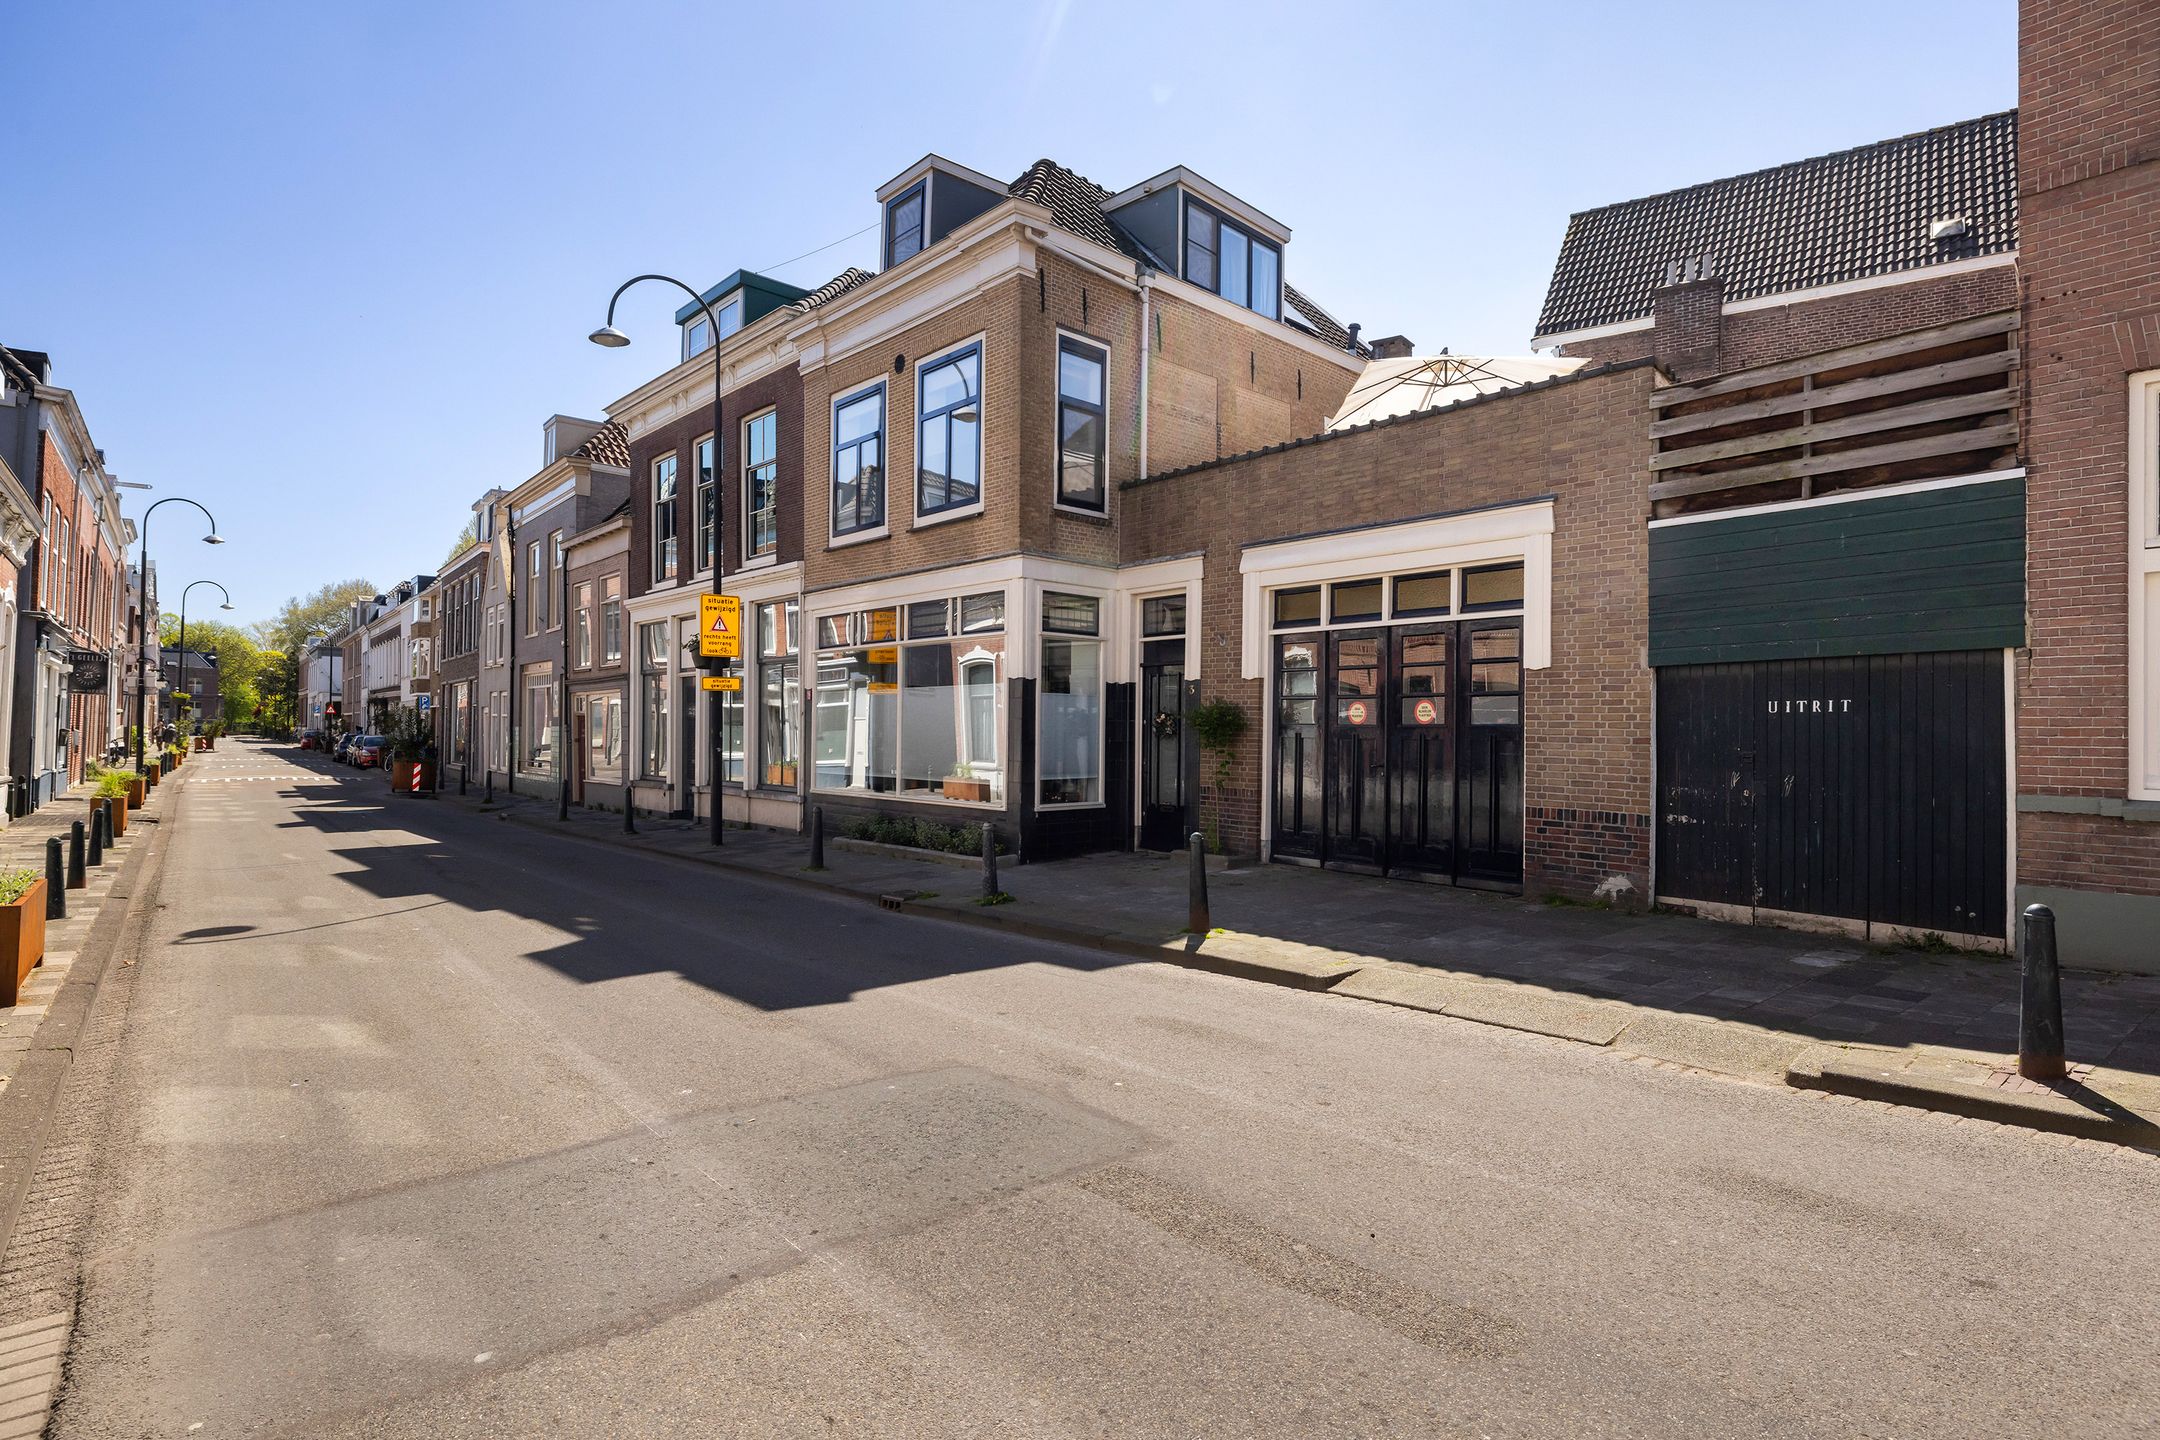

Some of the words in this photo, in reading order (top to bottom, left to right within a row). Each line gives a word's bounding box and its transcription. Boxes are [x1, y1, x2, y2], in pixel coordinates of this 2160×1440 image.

[705, 605, 736, 613] gewijzigd
[84, 671, 94, 679] 25
[1189, 685, 1195, 695] 3
[1768, 699, 1852, 714] UITRIT
